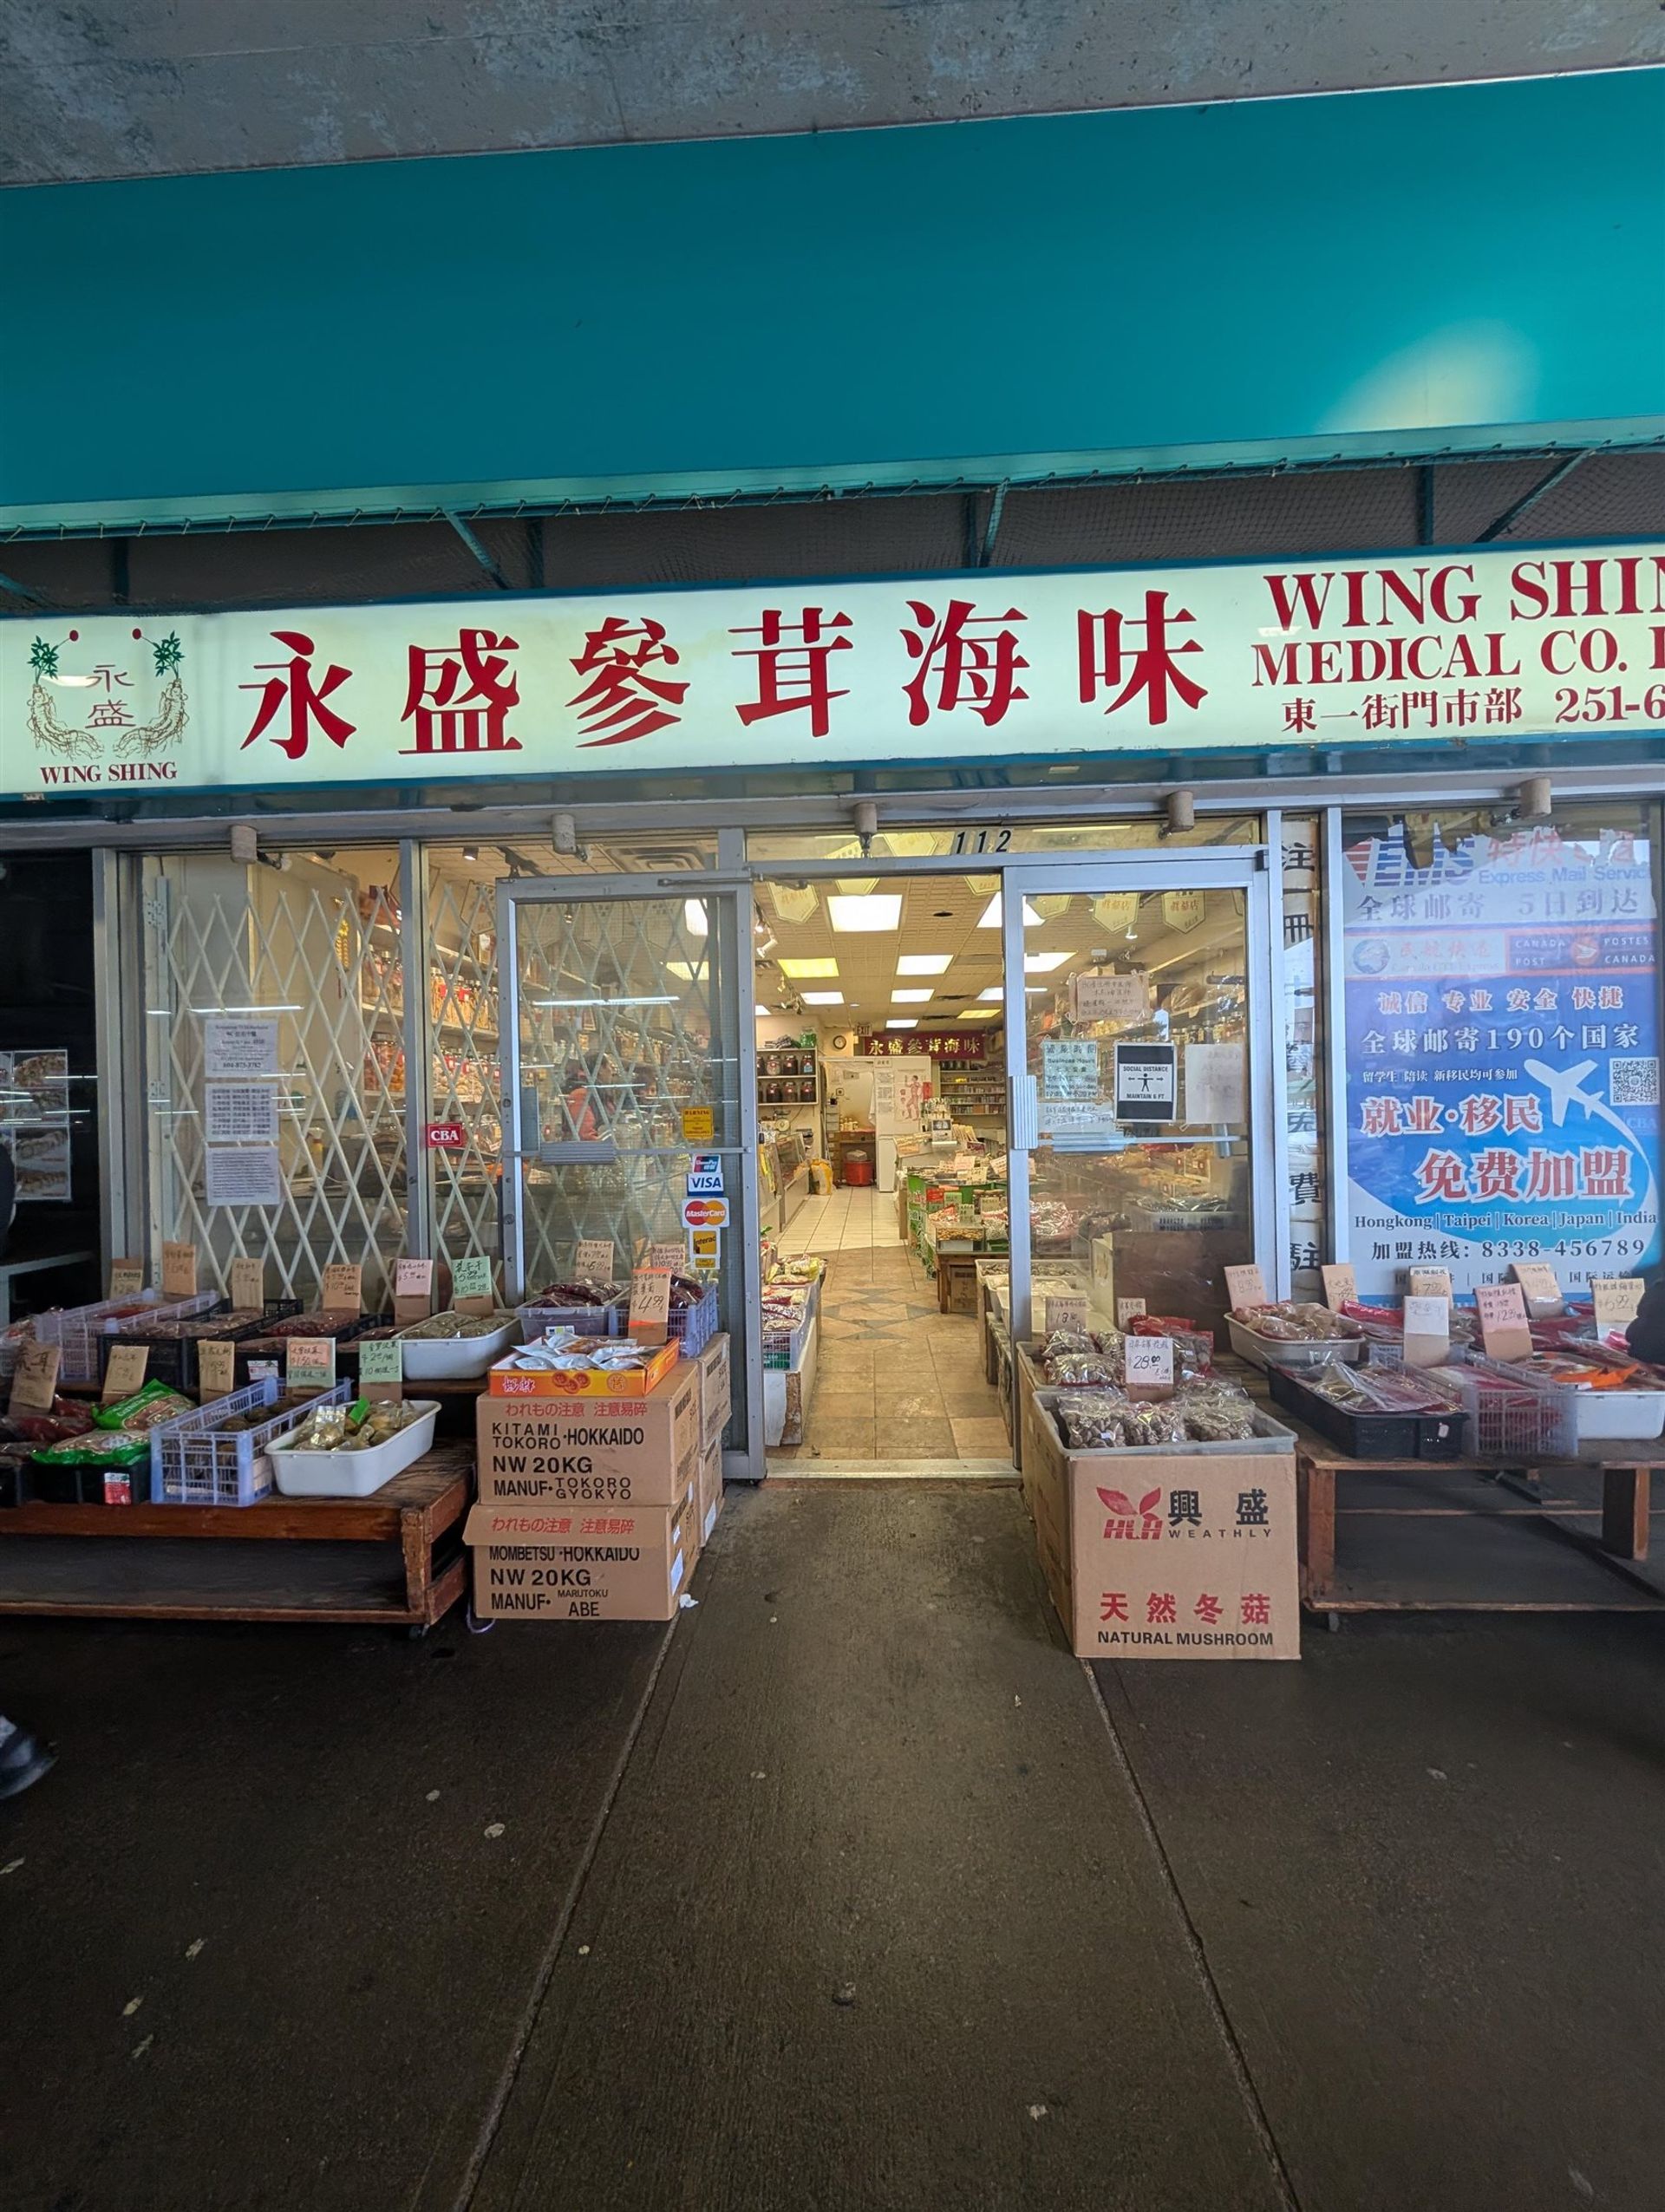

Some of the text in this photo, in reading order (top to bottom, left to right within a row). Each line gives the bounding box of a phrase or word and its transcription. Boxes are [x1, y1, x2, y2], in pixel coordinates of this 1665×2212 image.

[1263, 564, 1482, 630] WING
[1250, 633, 1522, 686] MEDICAL
[1540, 628, 1628, 675] CO.
[238, 591, 1209, 760] 永盛參茸海味
[85, 664, 136, 729] 永盛
[1282, 686, 1523, 734] 東一街門市部
[41, 761, 178, 785] WING SHING
[956, 830, 1012, 855] 112
[1479, 864, 1650, 884] Express Mail Servic
[1515, 939, 1566, 950] CANADA
[1515, 953, 1656, 967] POST CANADA
[1378, 985, 1624, 1015] 诚信 专业 安全 快捷
[1361, 1023, 1640, 1055] 全球邮寄190个国家
[1362, 1069, 1398, 1084] 留学生
[1361, 1093, 1544, 1138] 就业·移民
[430, 1130, 460, 1141] CBA
[691, 1178, 722, 1188] VISA
[1414, 1145, 1634, 1204] 免费加盟
[1355, 1210, 1657, 1230] Hongkong Taipei Korea Japan India
[1481, 1239, 1645, 1257] 8338-456789
[506, 1402, 648, 1418] われもの注意 注意易碎
[493, 1422, 558, 1436] KITAMI
[493, 1437, 561, 1450] TOKORO
[493, 1457, 526, 1473] NW
[555, 1477, 631, 1489] TOKORO
[556, 1489, 631, 1500] GYOKYO
[1168, 1489, 1269, 1527] 興盛
[492, 1518, 635, 1534] われもの注意 注意易碎
[1168, 1529, 1272, 1538] WEATHLY
[489, 1546, 555, 1561] MOMBETSU
[490, 1569, 524, 1586] NW
[558, 1589, 608, 1598] MARUTOKU
[568, 1602, 600, 1616] ABE
[1100, 1592, 1271, 1625] 天然冬菇
[1098, 1630, 1274, 1647] NATURAL MUSHROOM
